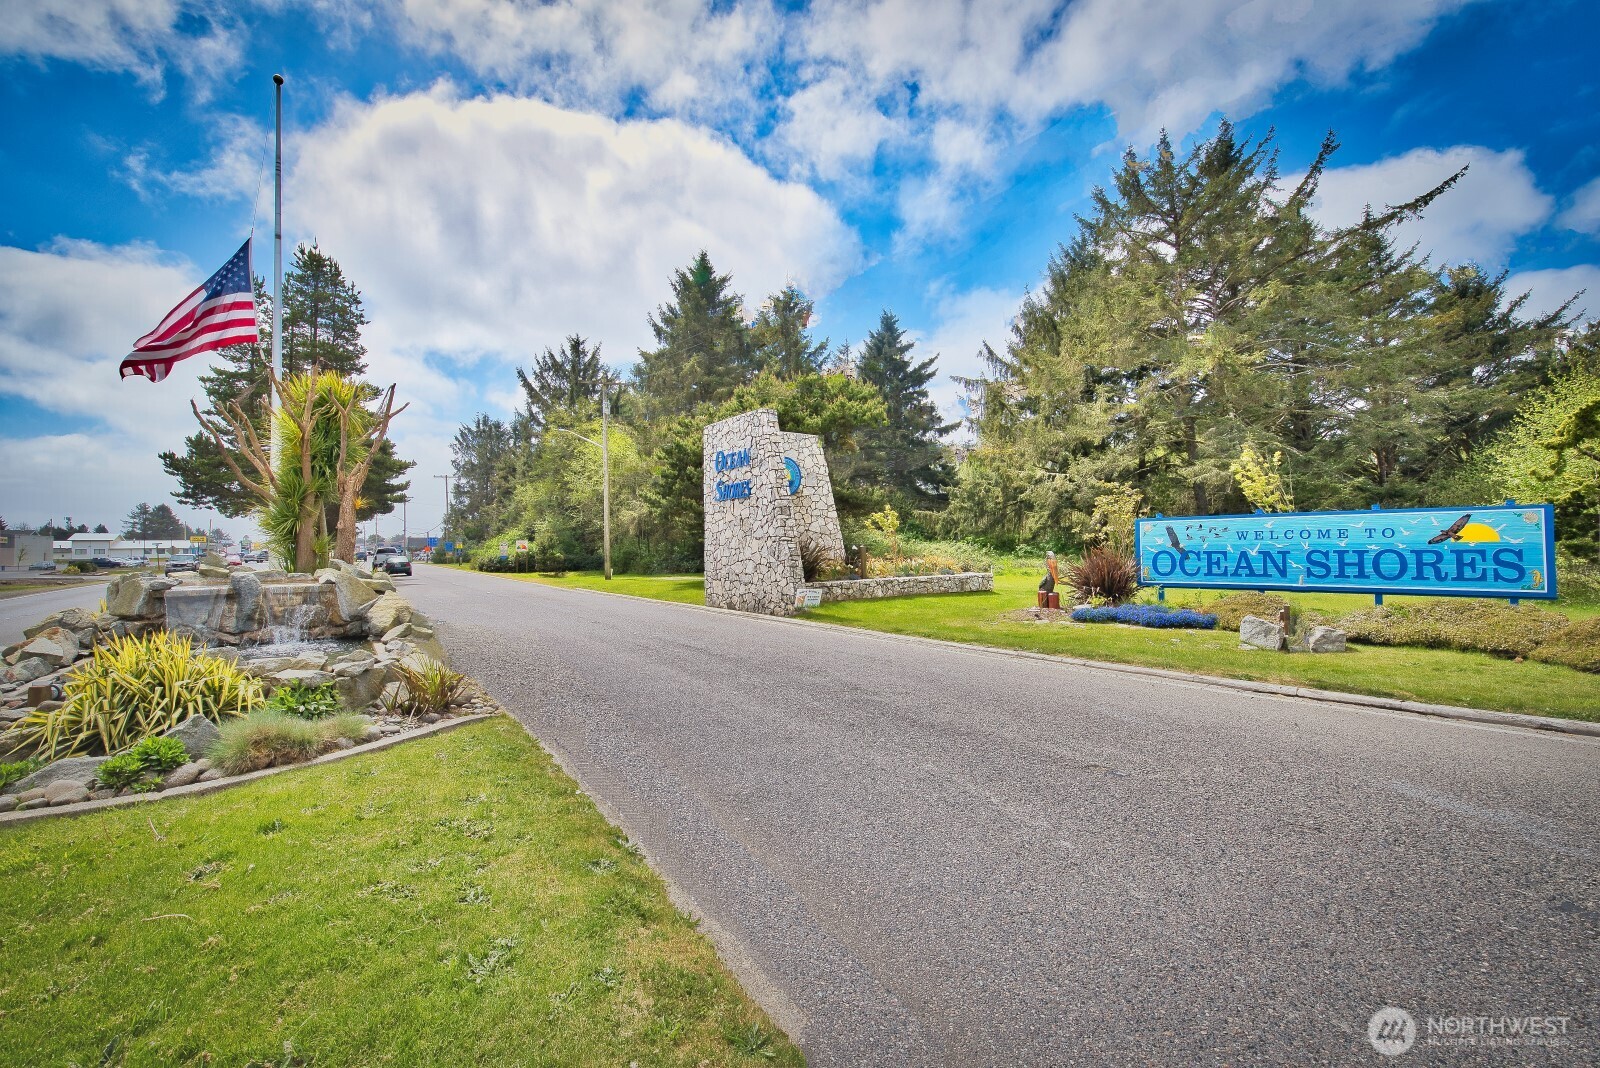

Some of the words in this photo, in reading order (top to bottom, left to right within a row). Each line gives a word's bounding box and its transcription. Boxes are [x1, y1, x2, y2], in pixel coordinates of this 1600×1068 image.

[1236, 528, 1349, 541] WELCOME
[1364, 527, 1396, 539] TO
[1151, 549, 1291, 579] OCEAN
[1306, 548, 1527, 584] SHORES
